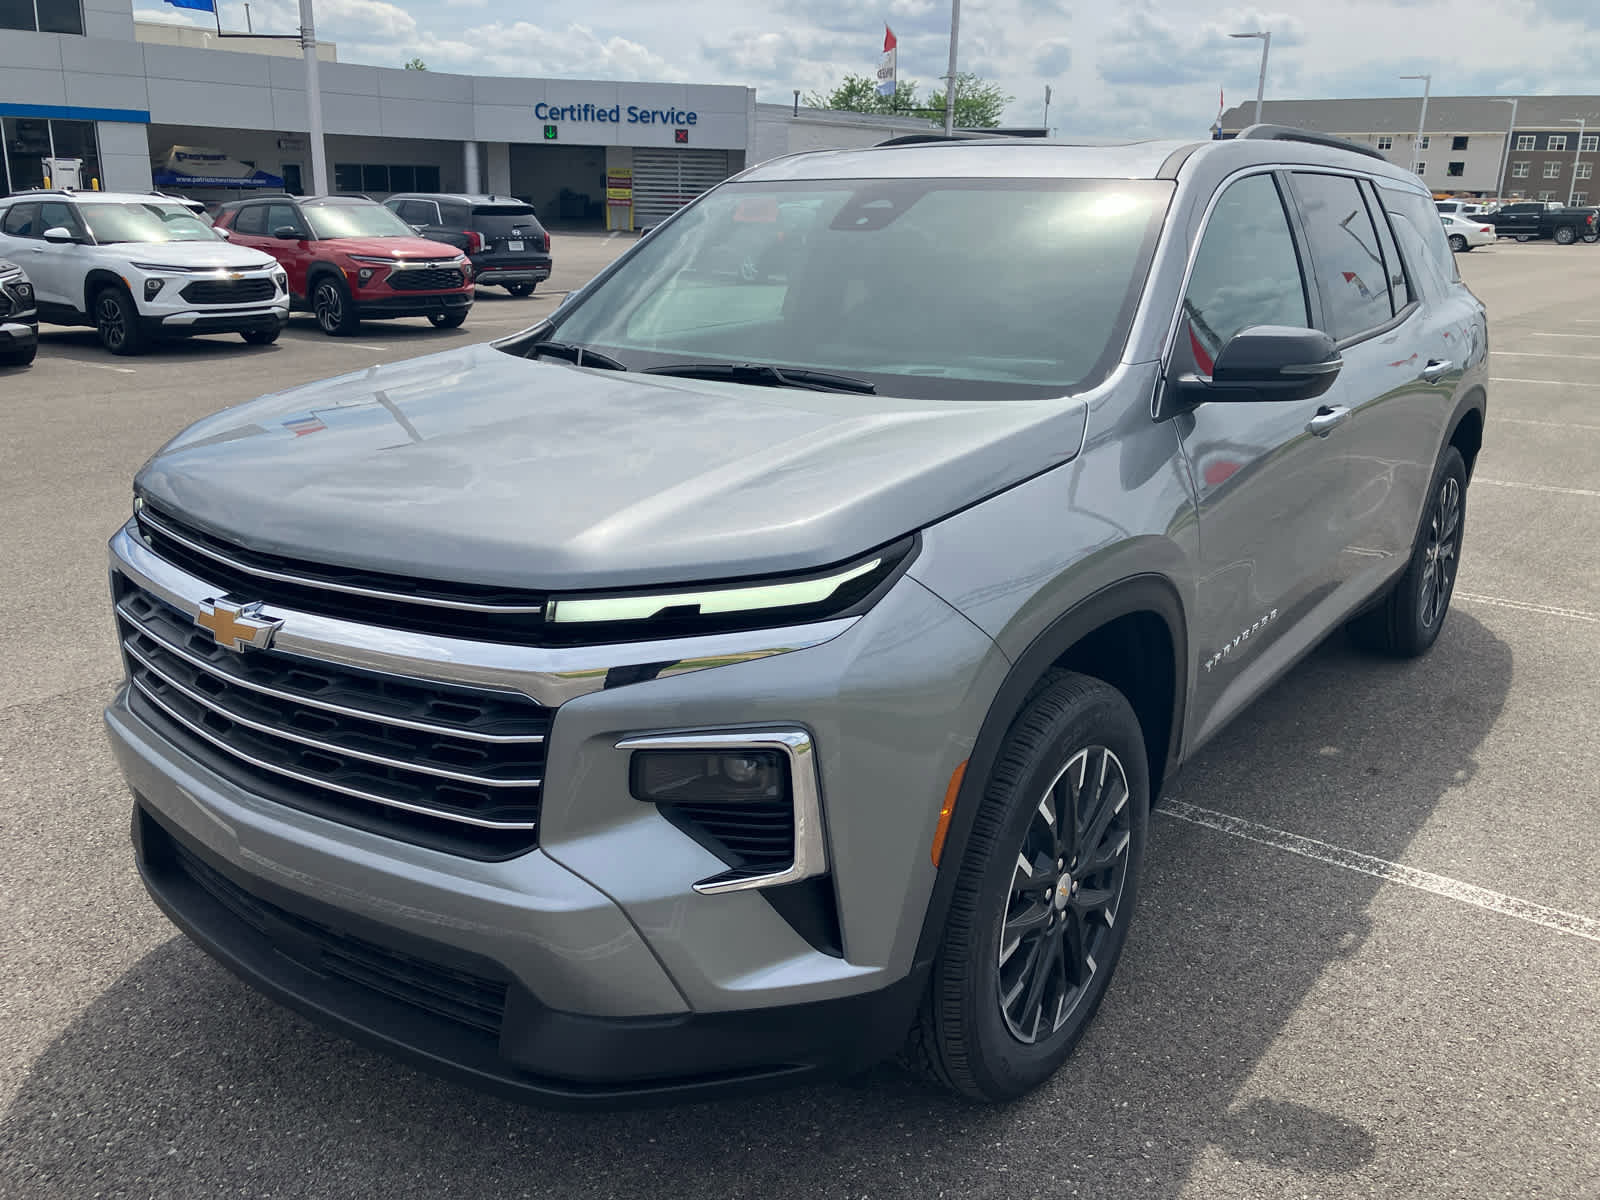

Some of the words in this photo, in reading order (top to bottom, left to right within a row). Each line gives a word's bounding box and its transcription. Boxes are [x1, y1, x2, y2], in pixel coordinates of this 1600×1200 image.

[534, 102, 620, 123] Certified
[628, 105, 698, 125] Service
[1205, 608, 1278, 672] TRAVERSE
